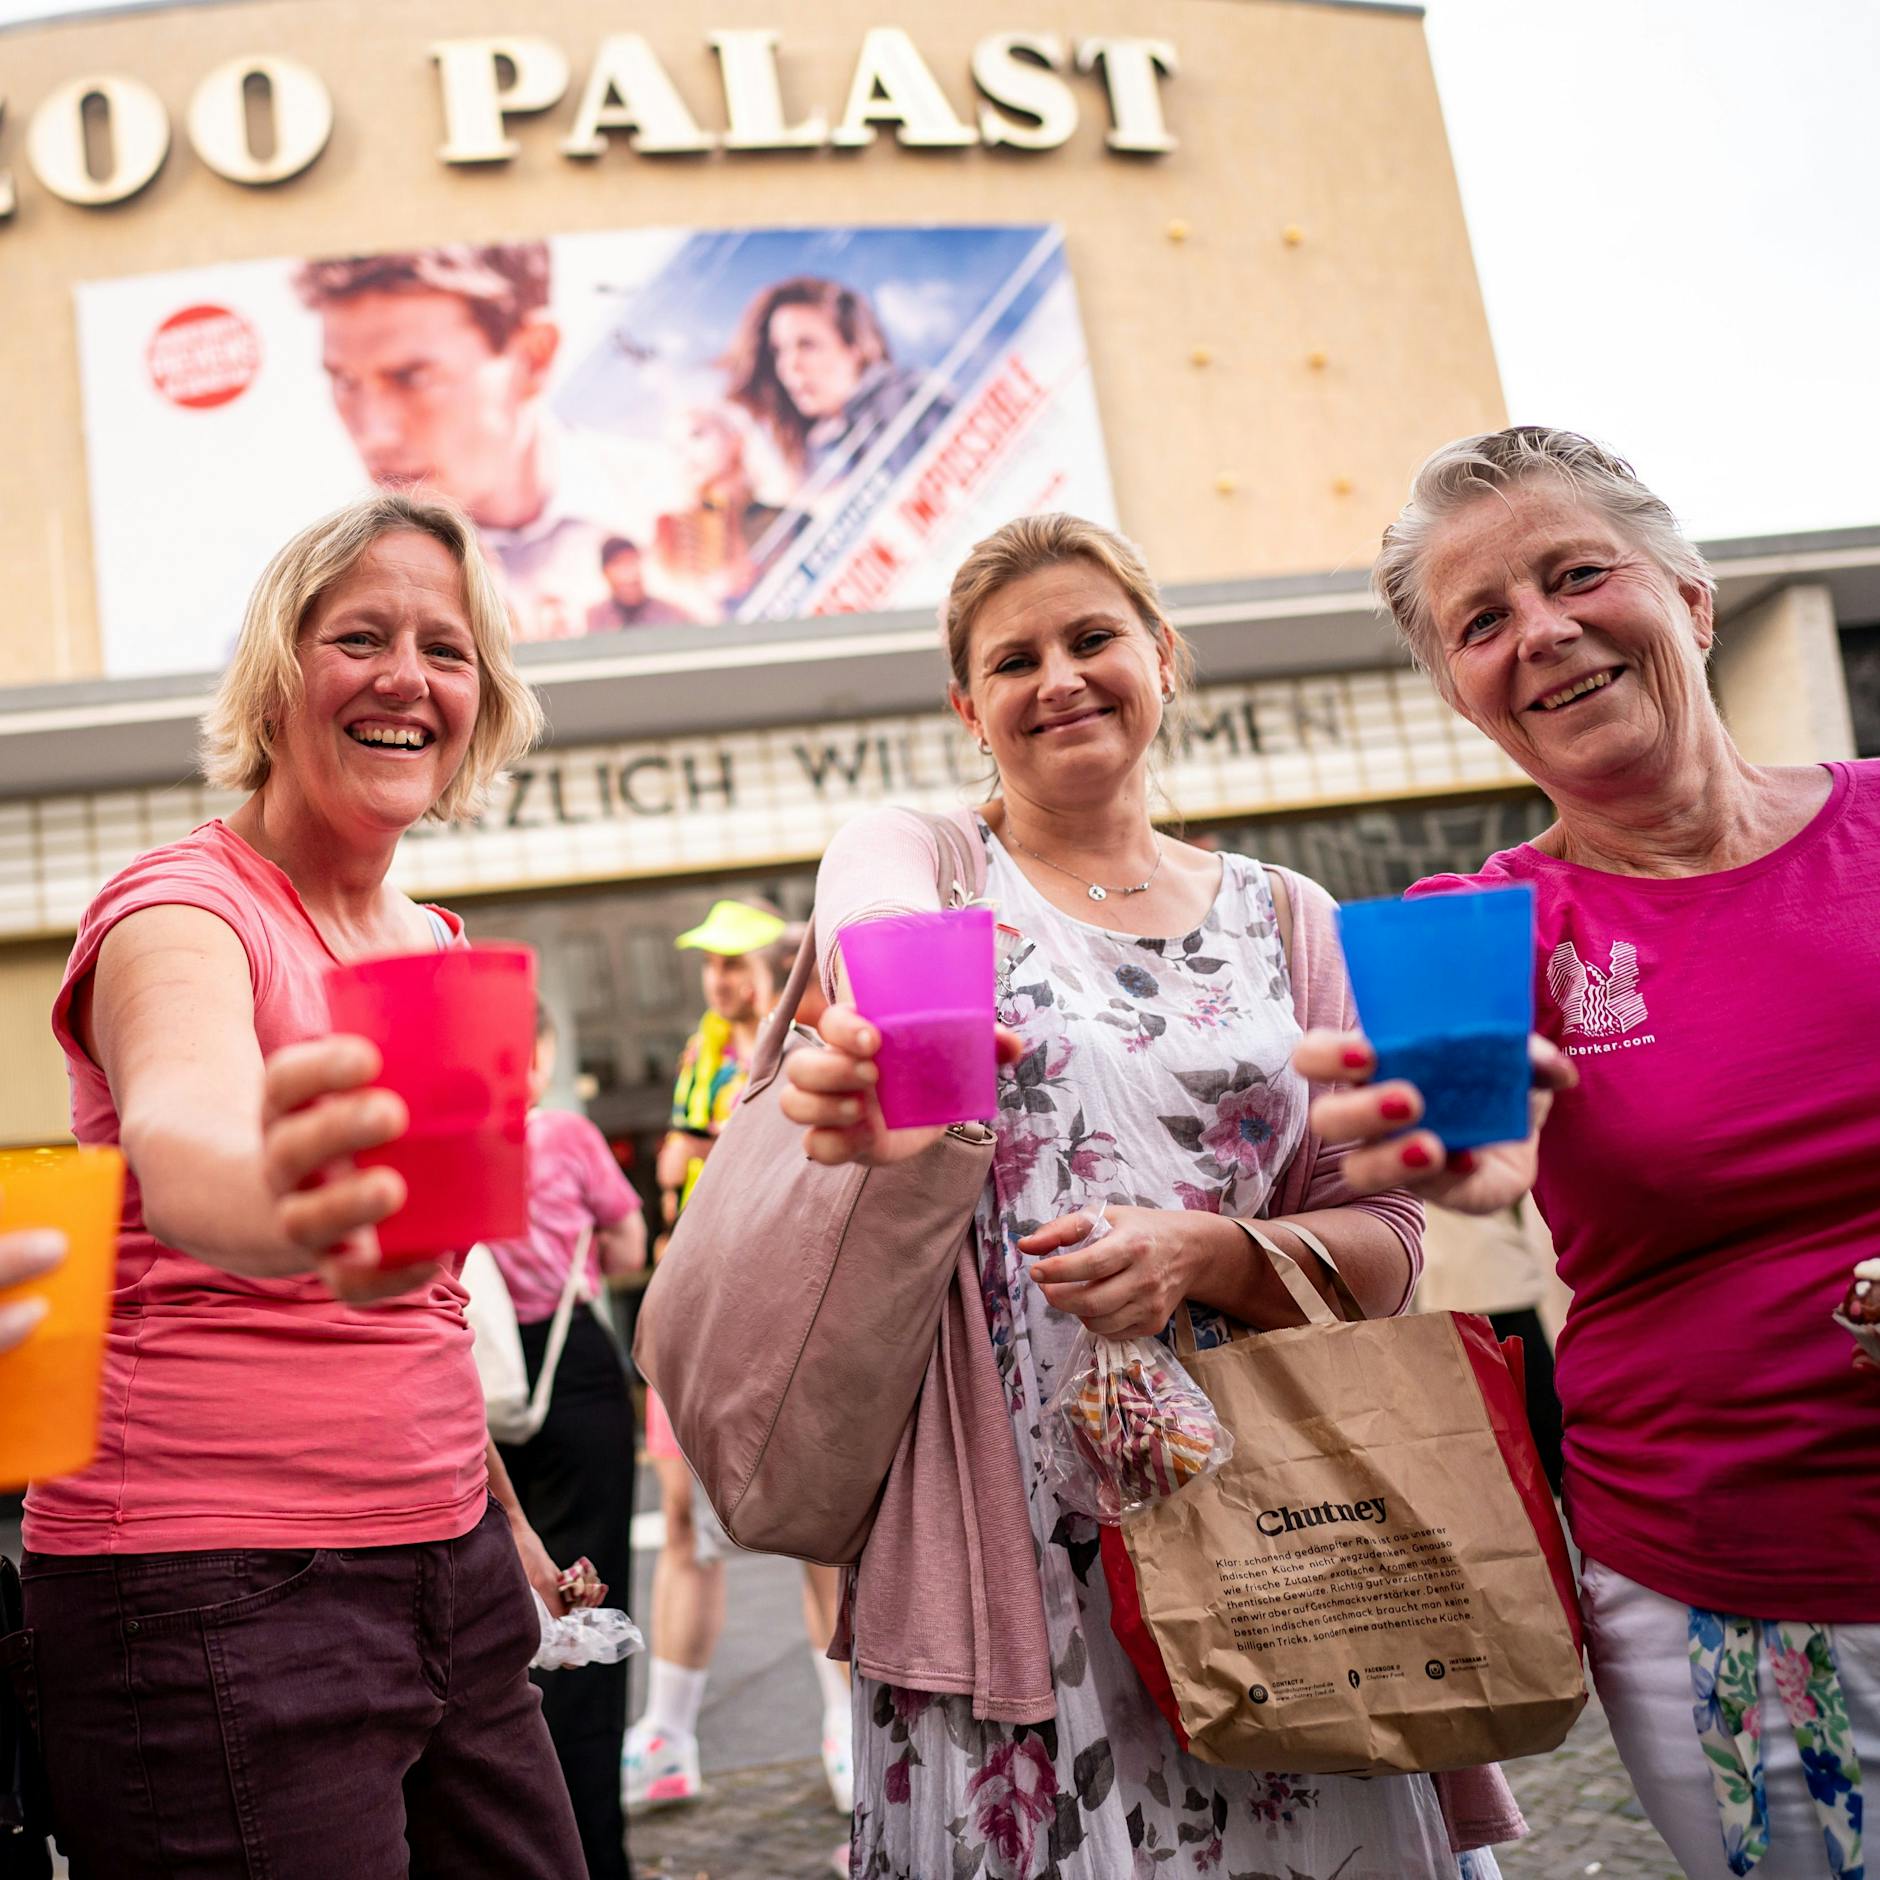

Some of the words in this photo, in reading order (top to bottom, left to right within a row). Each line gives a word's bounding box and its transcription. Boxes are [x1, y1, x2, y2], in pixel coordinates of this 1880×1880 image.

[0, 56, 334, 218] OO
[429, 27, 1178, 165] PALAST
[1256, 1497, 1386, 1537] Chutney
[1216, 1558, 1242, 1569] Klar:
[1244, 1551, 1292, 1566] schonend
[1294, 1540, 1352, 1559] gedämpfter
[1356, 1537, 1377, 1546] Reis
[1379, 1536, 1391, 1545] ist
[1393, 1534, 1409, 1542] aus
[1410, 1527, 1446, 1539] unserer
[1219, 1569, 1268, 1582] indischen
[1272, 1564, 1305, 1575] Küche
[1309, 1557, 1335, 1569] nicht
[1340, 1548, 1409, 1563] wegzudenken.
[1412, 1540, 1453, 1553] Genauso
[1223, 1585, 1242, 1596] wie
[1245, 1581, 1281, 1593] frische
[1330, 1562, 1375, 1578] exotische
[1379, 1559, 1418, 1572] Aromen
[1421, 1557, 1438, 1567] und
[1440, 1554, 1458, 1564] au-
[1226, 1594, 1281, 1610] thentische
[1283, 1588, 1329, 1601] Gewürze.
[1330, 1580, 1363, 1593] Richtig
[1366, 1579, 1383, 1589] gut
[1230, 1614, 1249, 1624] nen
[1251, 1612, 1266, 1621] wir
[1268, 1608, 1290, 1618] aber
[1292, 1605, 1309, 1615] auf
[1426, 1585, 1449, 1595] Denn
[1451, 1581, 1465, 1591] für
[1233, 1627, 1269, 1637] besten
[1272, 1617, 1321, 1632] indischen
[1322, 1608, 1374, 1624] Geschmack
[1376, 1601, 1419, 1615] braucht
[1421, 1602, 1442, 1611] man
[1444, 1598, 1470, 1608] keine
[1236, 1641, 1276, 1652] billigen
[1277, 1634, 1312, 1647] Tricks,
[1313, 1627, 1347, 1641] sondern
[1348, 1624, 1370, 1634] eine
[1371, 1616, 1438, 1631] authentische
[1439, 1611, 1475, 1623] Küche.
[1272, 1679, 1298, 1688] CONTACT
